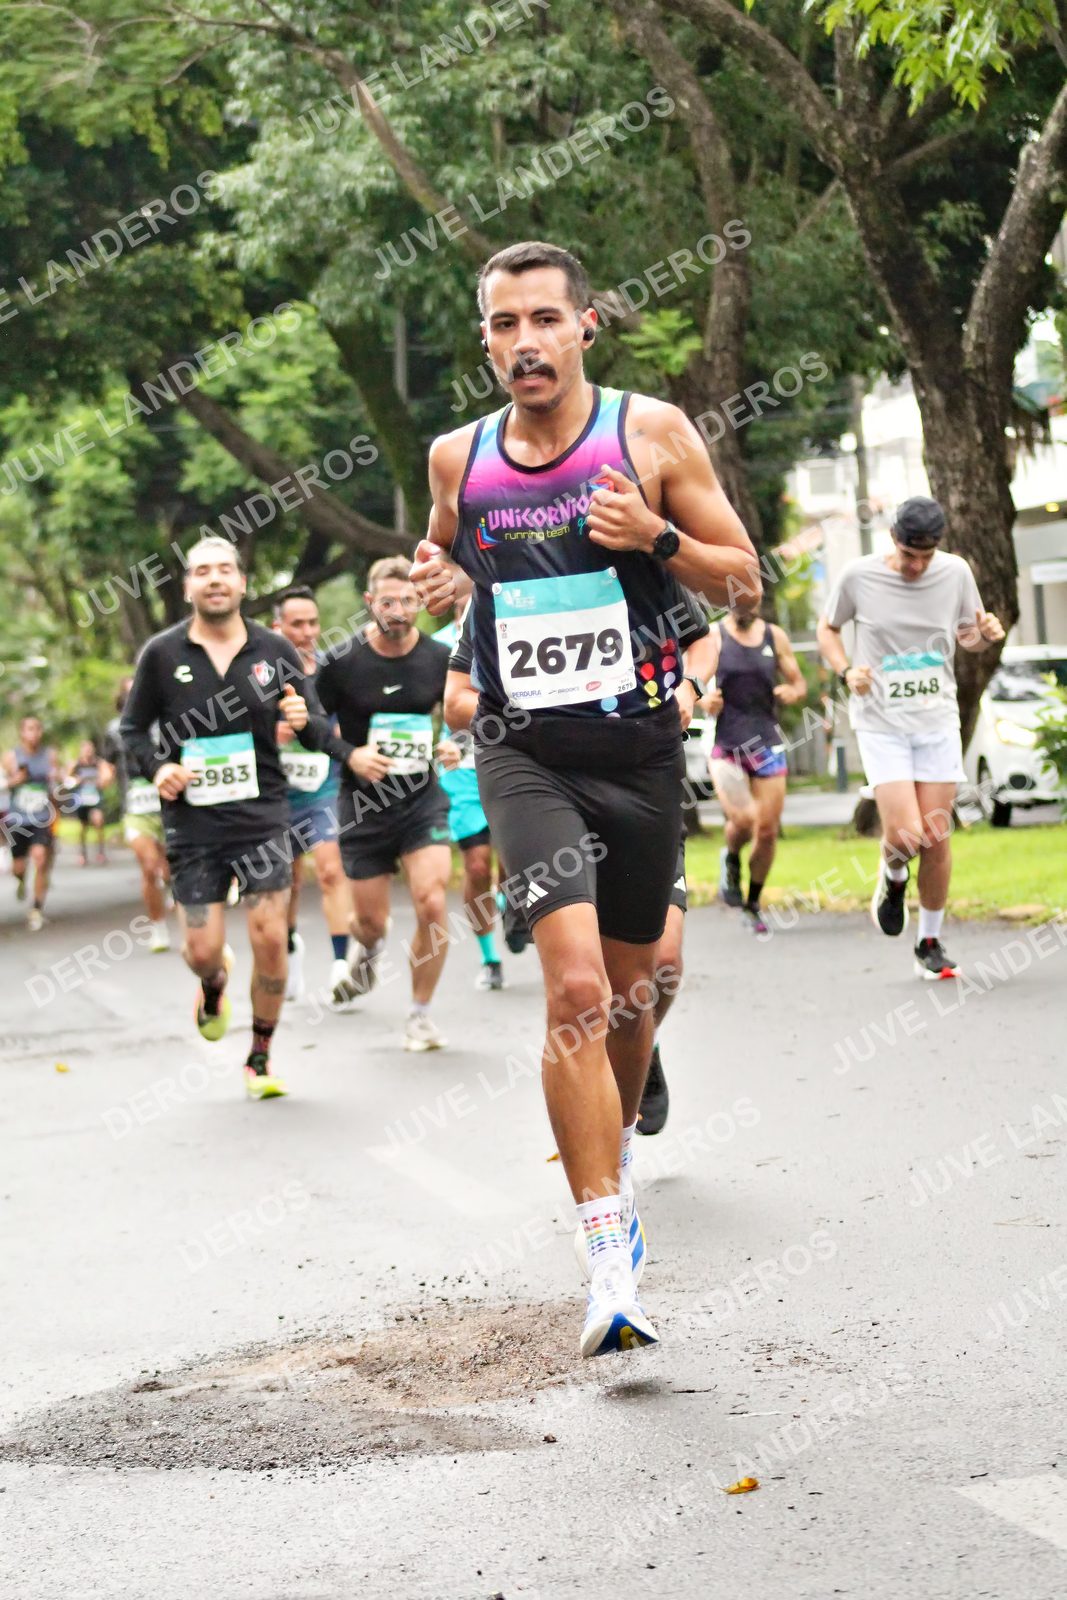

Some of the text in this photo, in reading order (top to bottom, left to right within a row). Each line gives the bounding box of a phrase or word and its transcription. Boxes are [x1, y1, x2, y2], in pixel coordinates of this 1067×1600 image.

[504, 529, 545, 541] running
[546, 525, 570, 538] team
[507, 628, 623, 679] 2679
[889, 677, 940, 698] 2548
